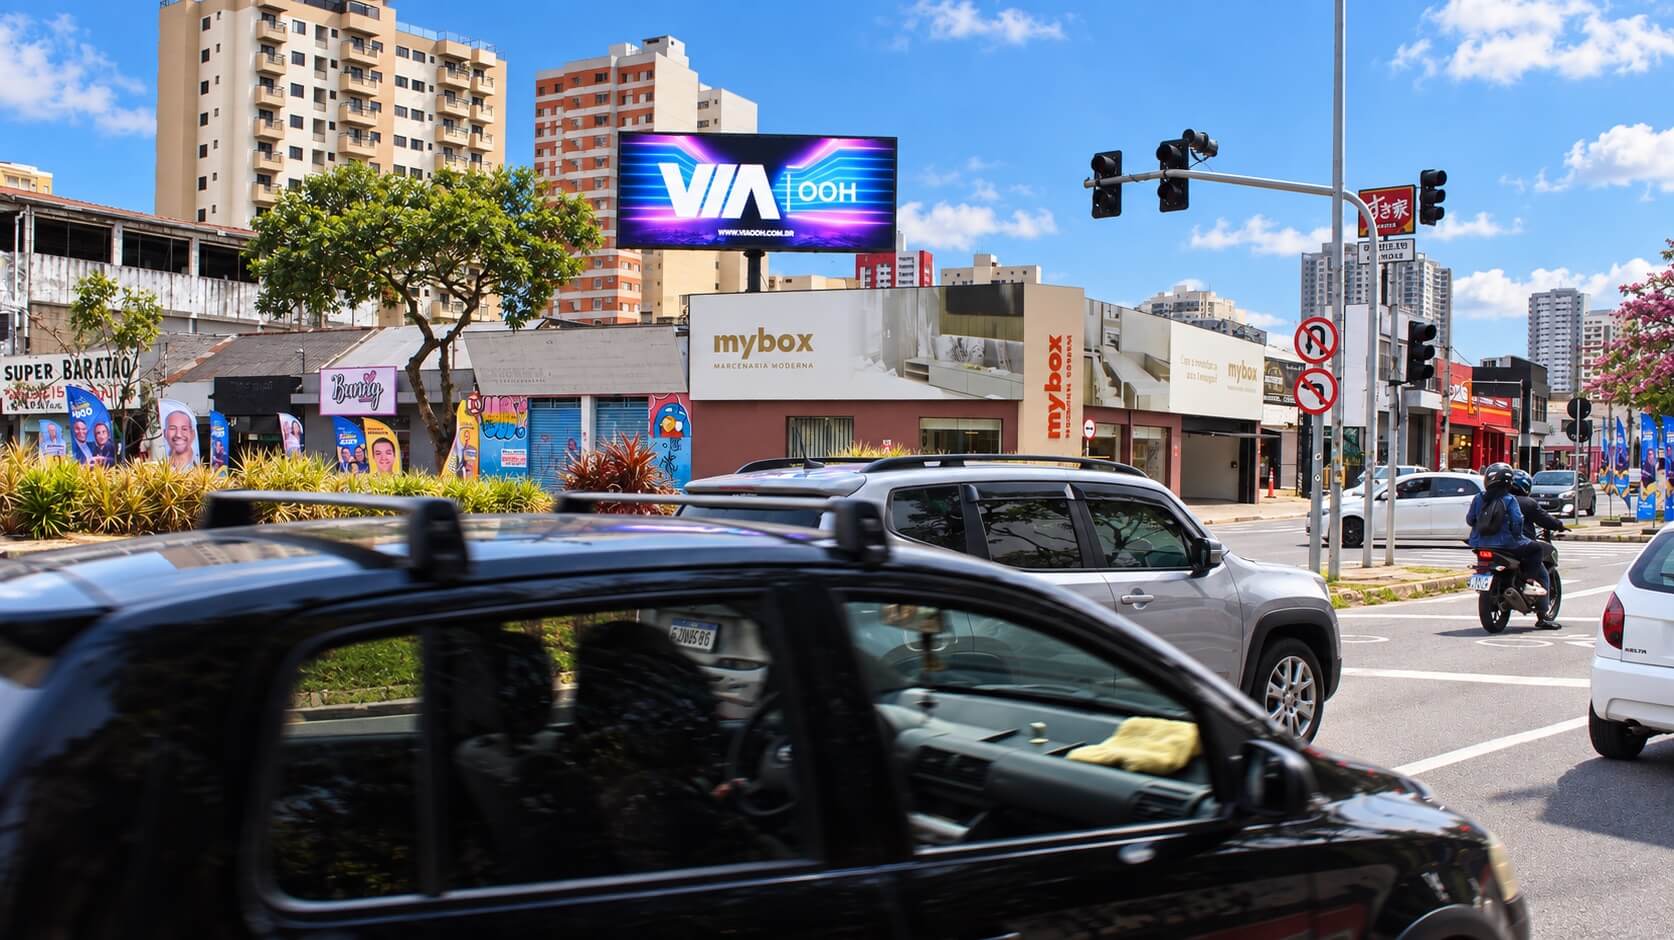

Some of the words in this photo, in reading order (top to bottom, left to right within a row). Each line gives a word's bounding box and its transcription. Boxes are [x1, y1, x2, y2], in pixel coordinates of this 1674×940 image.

[658, 162, 781, 220] VIA
[798, 181, 857, 203] OOH
[713, 326, 814, 360] mybox
[4, 363, 53, 382] SUPER
[713, 361, 769, 369] MARCENARIA
[771, 361, 814, 369] MODERNA
[1227, 359, 1258, 384] mybox
[331, 373, 384, 411] Bunny
[1044, 334, 1067, 439] mybox
